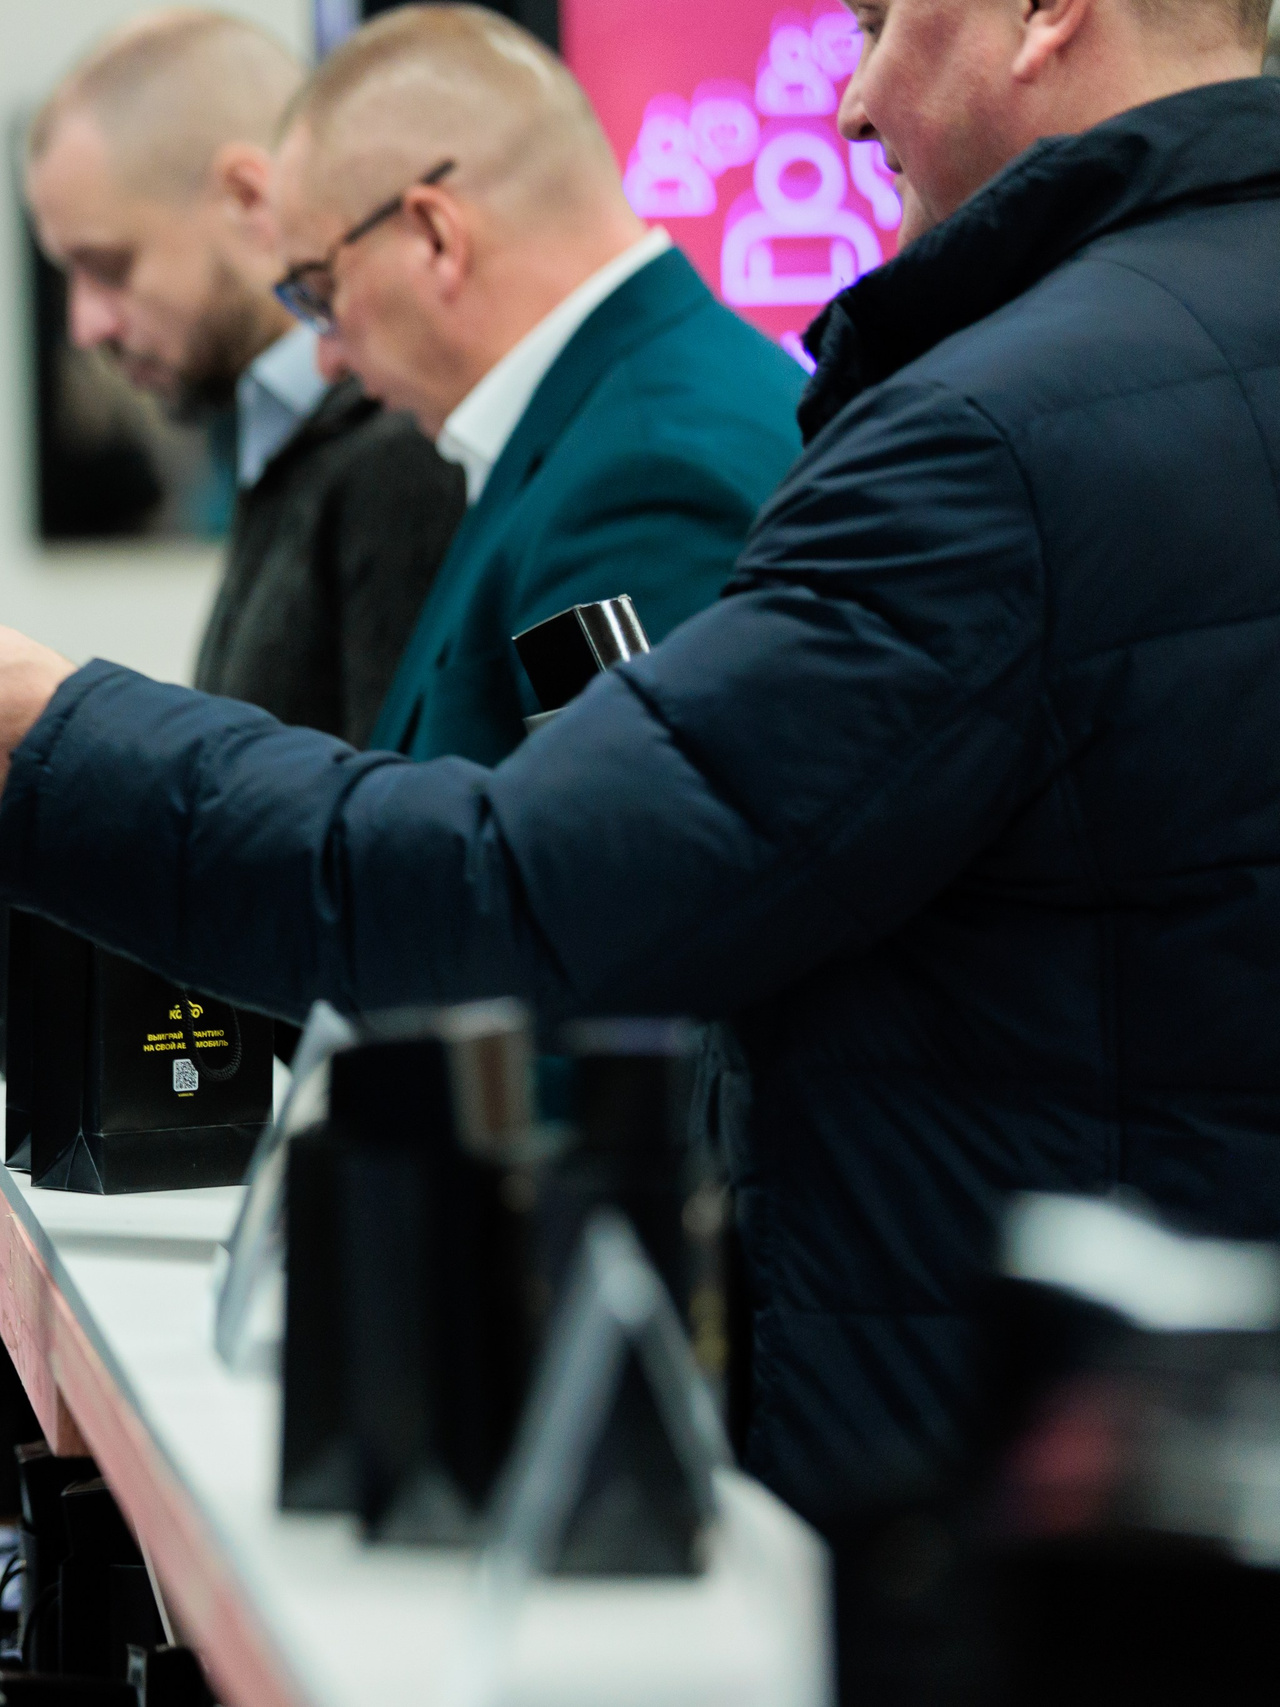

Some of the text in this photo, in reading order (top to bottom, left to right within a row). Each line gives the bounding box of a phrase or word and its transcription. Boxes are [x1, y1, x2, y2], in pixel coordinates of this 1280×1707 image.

[147, 1031, 183, 1041] ВЫИГРАЙ
[143, 1040, 229, 1052] НА СВОЙ АВМОБИЛЬ
